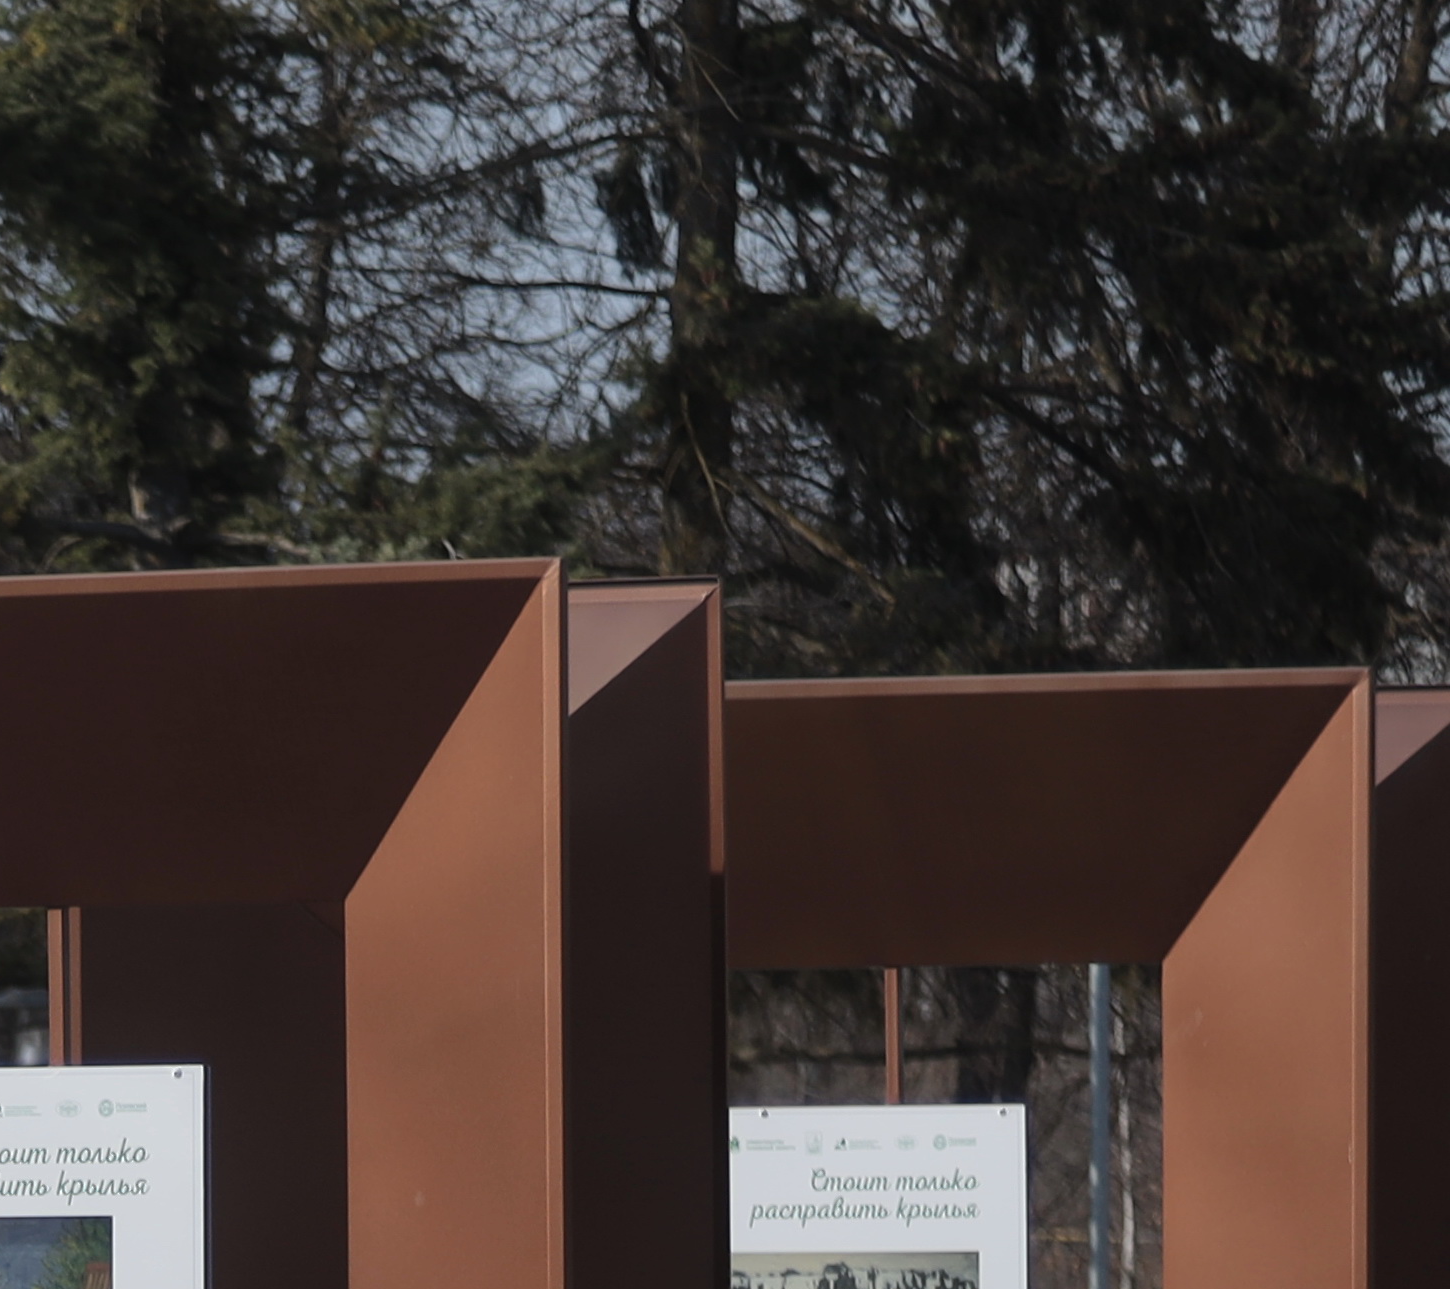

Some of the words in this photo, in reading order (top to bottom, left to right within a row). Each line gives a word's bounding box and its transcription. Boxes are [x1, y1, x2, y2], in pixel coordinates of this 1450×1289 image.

[56, 1137, 149, 1164] только
[56, 1170, 149, 1206] крылья
[811, 1168, 891, 1192] Стоит
[895, 1168, 979, 1191] только
[749, 1196, 891, 1229] расправить
[896, 1196, 979, 1228] крылья
